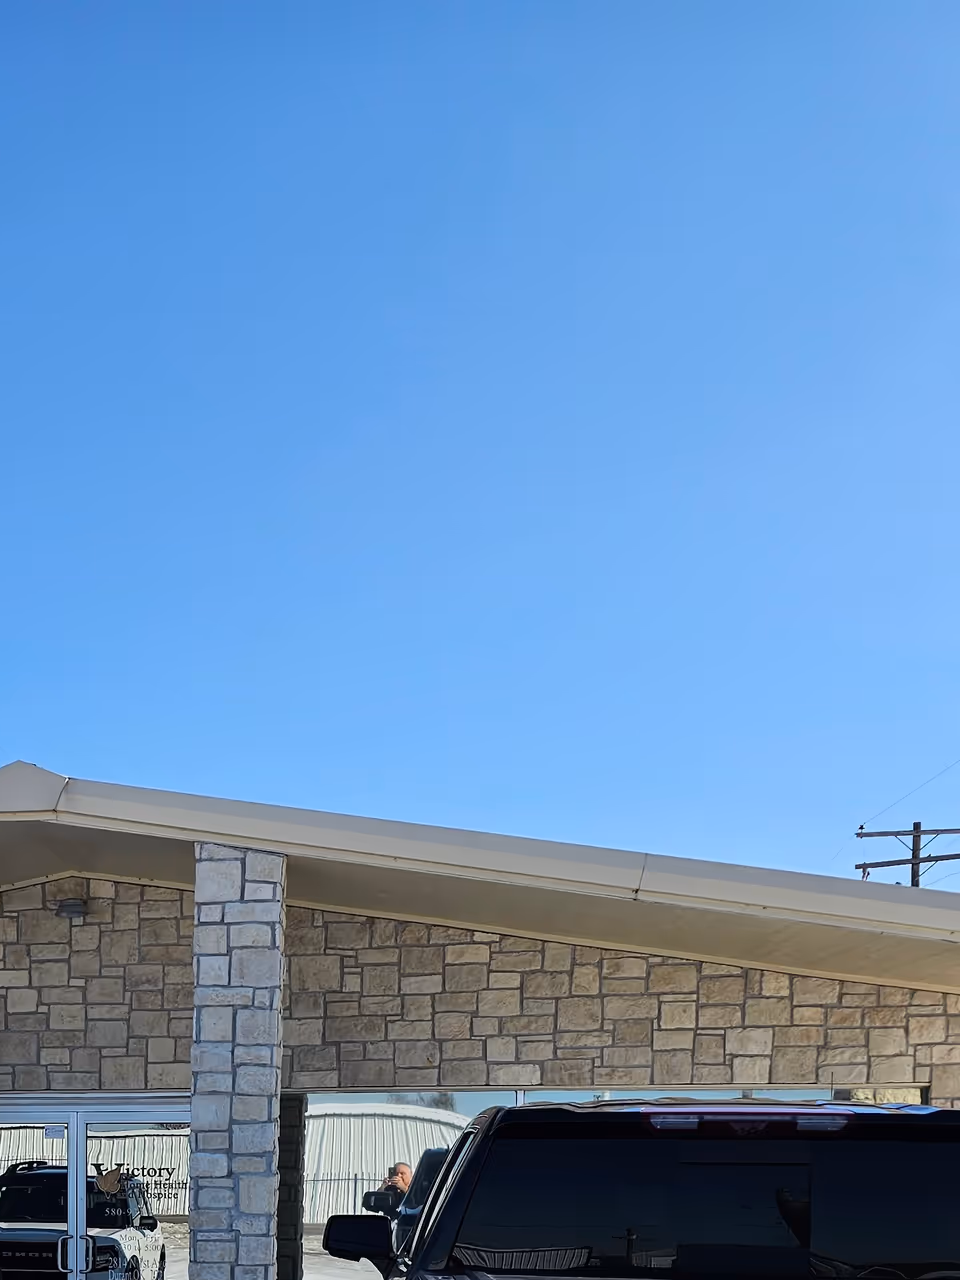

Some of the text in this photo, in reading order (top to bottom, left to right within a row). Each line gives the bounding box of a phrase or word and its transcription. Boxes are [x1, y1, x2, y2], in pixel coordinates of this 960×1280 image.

[91, 1163, 176, 1181] Victory
[153, 1180, 188, 1190] Health
[114, 1244, 132, 1252] 830
[144, 1244, 161, 1252] 5:00
[108, 1269, 132, 1280] Durant
